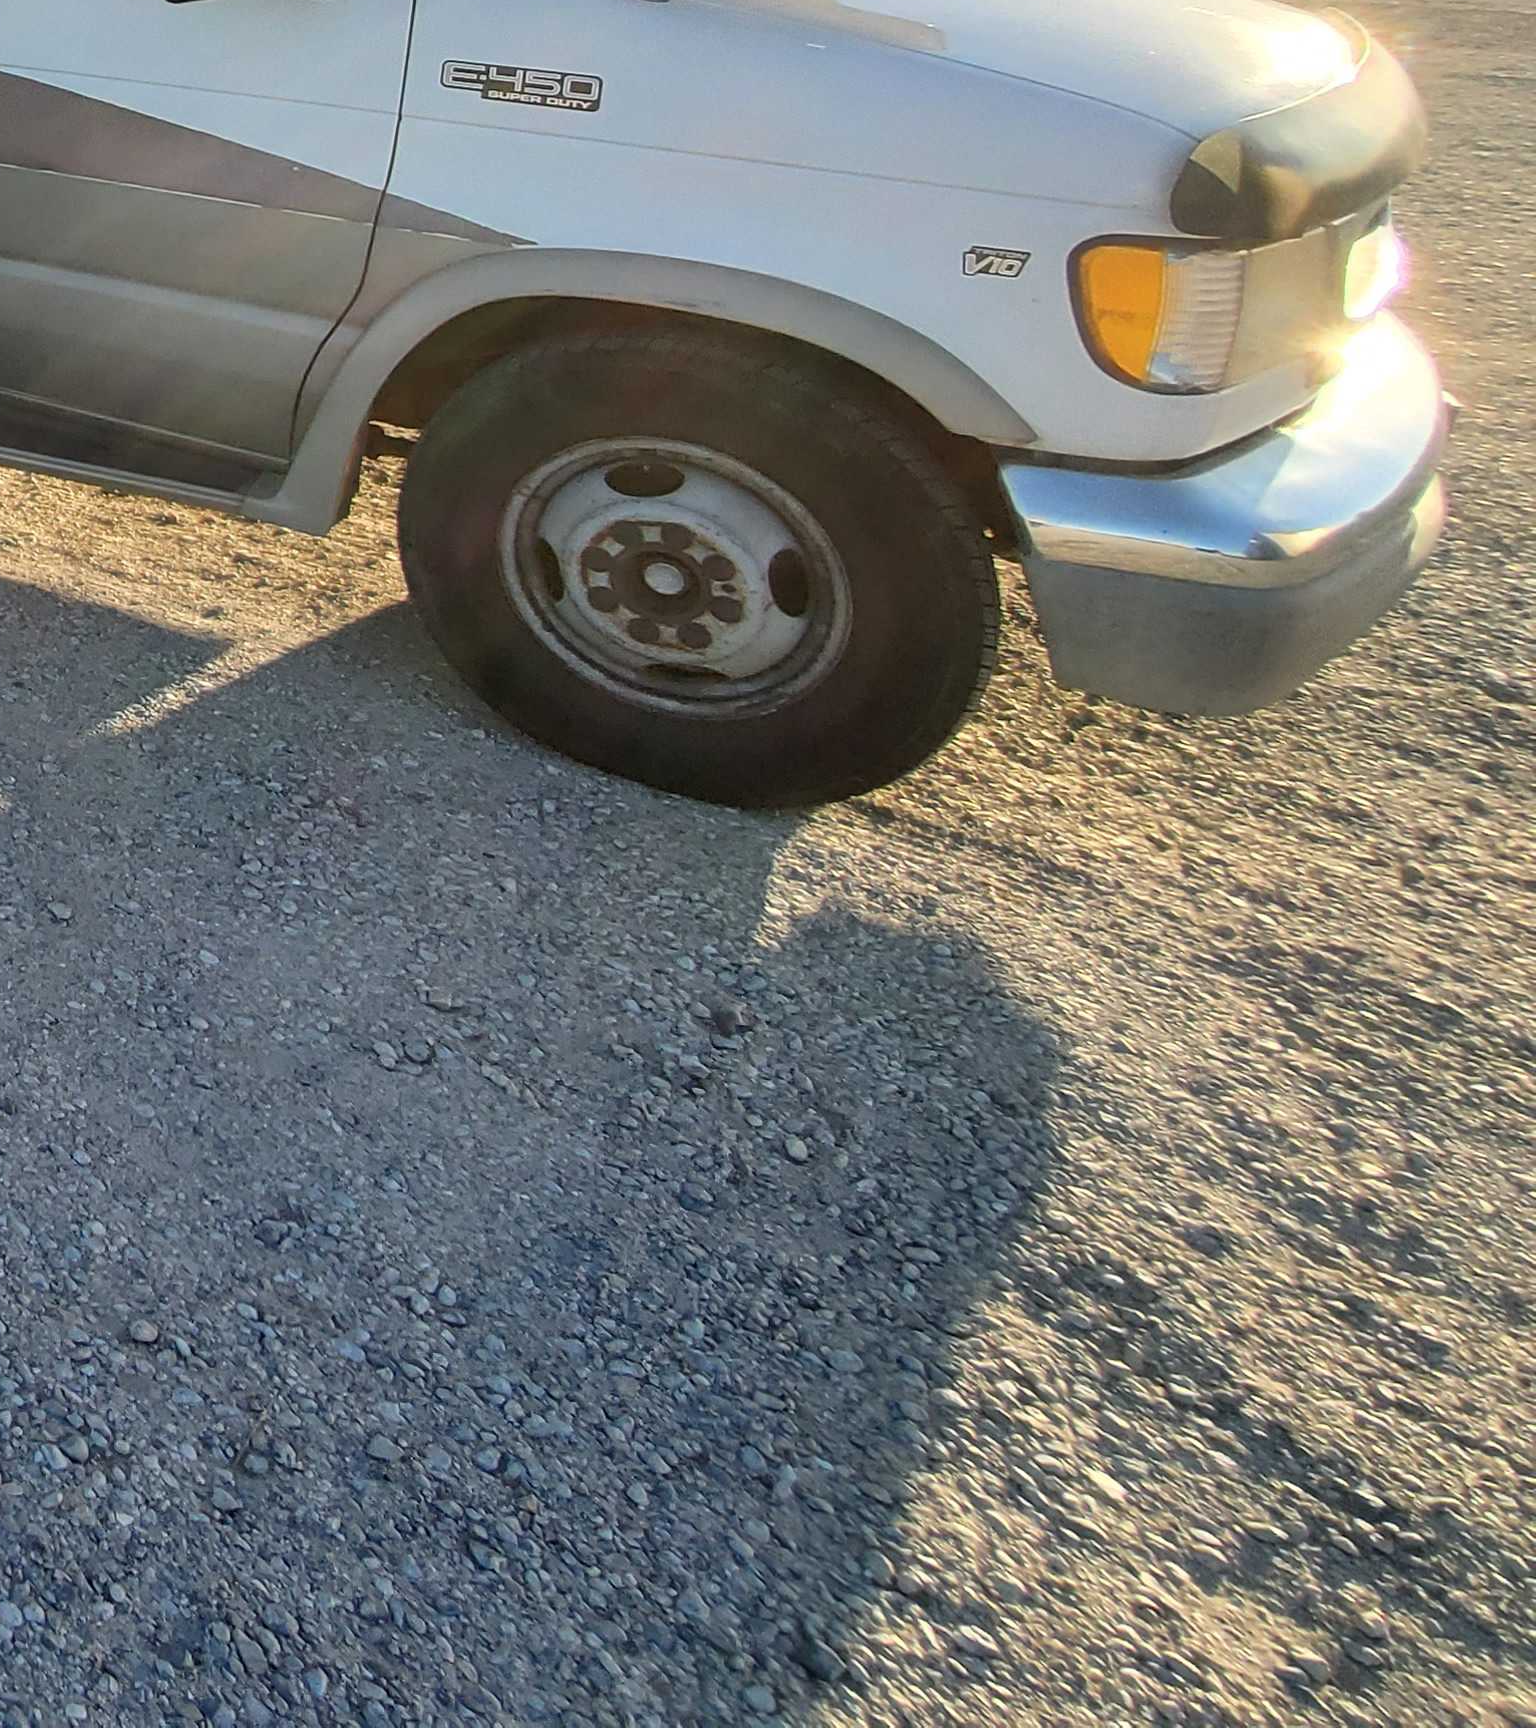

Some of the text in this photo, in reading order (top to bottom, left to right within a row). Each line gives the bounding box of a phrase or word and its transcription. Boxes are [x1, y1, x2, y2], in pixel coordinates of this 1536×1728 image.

[488, 90, 593, 110] SUPER DUTY
[965, 253, 1023, 276] V10
